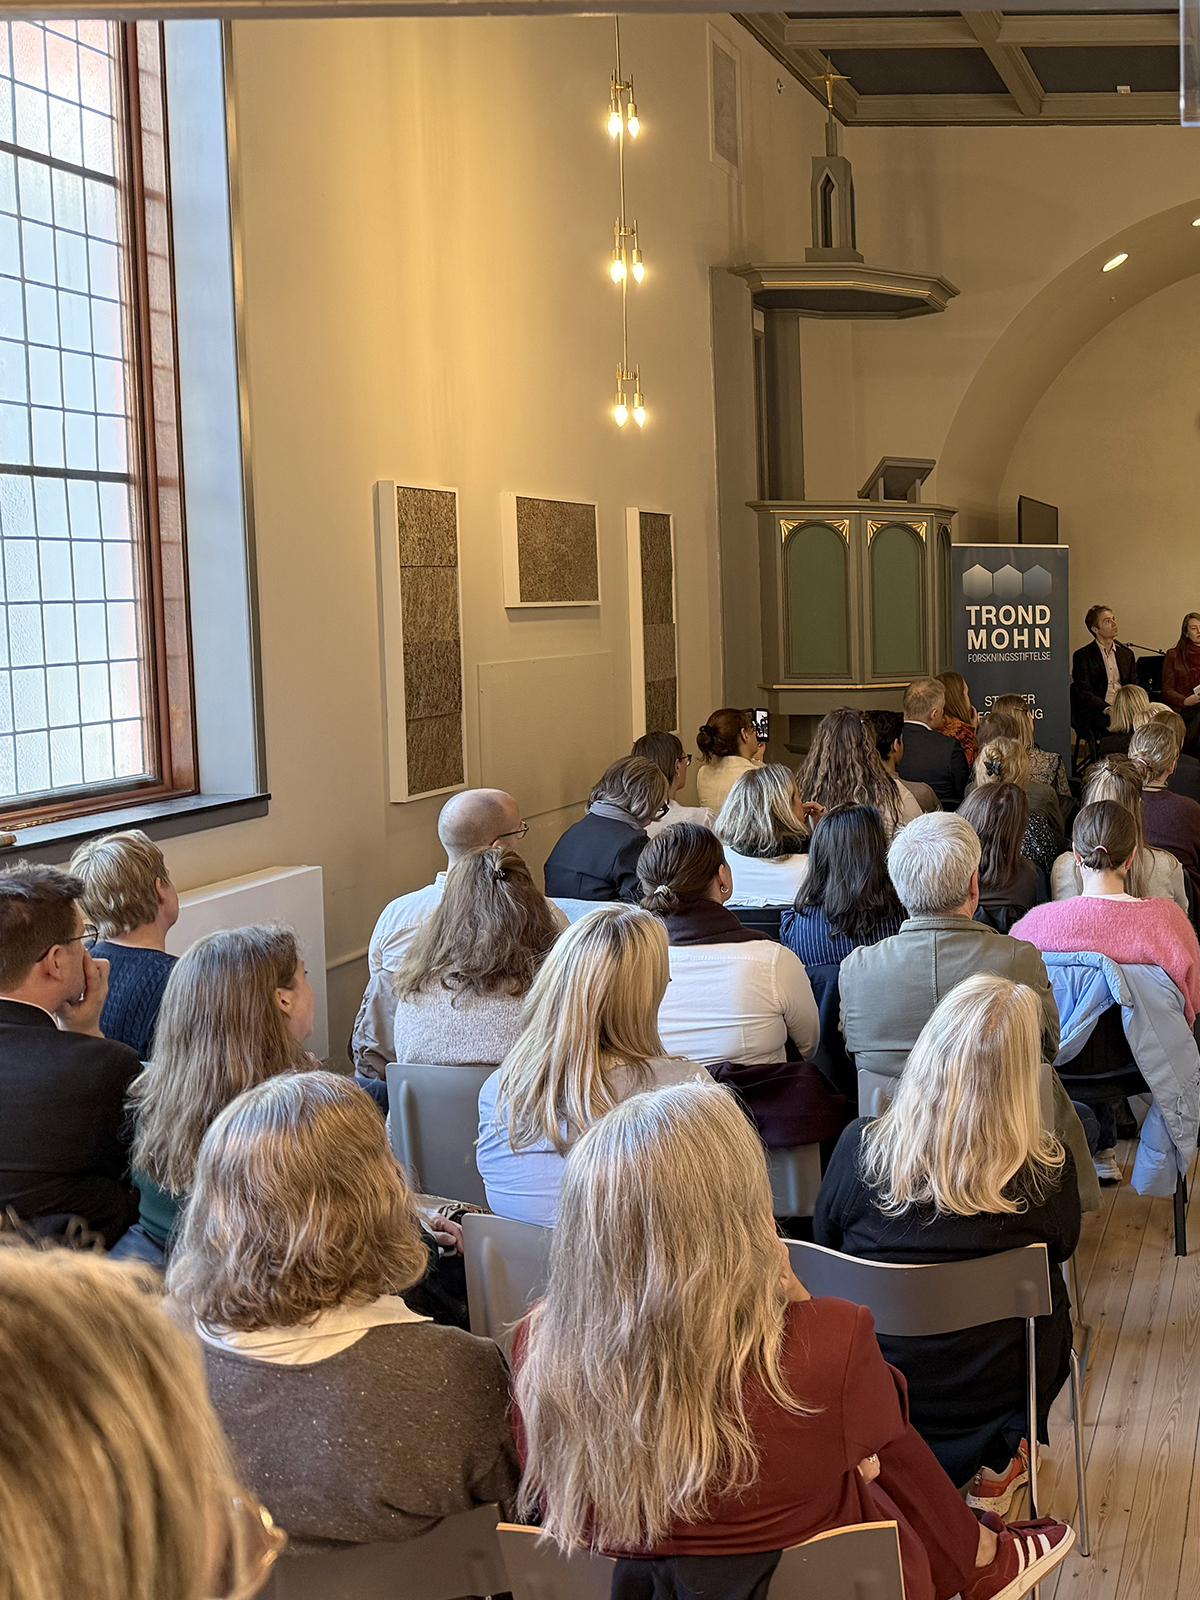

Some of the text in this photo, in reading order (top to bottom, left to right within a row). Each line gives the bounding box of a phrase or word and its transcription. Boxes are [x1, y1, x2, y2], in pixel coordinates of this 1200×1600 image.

[965, 604, 1051, 626] TROND
[967, 627, 1051, 650] MOHN
[967, 651, 1051, 663] FORSKNINGSSTIFTELSE
[984, 693, 1036, 707] STER
